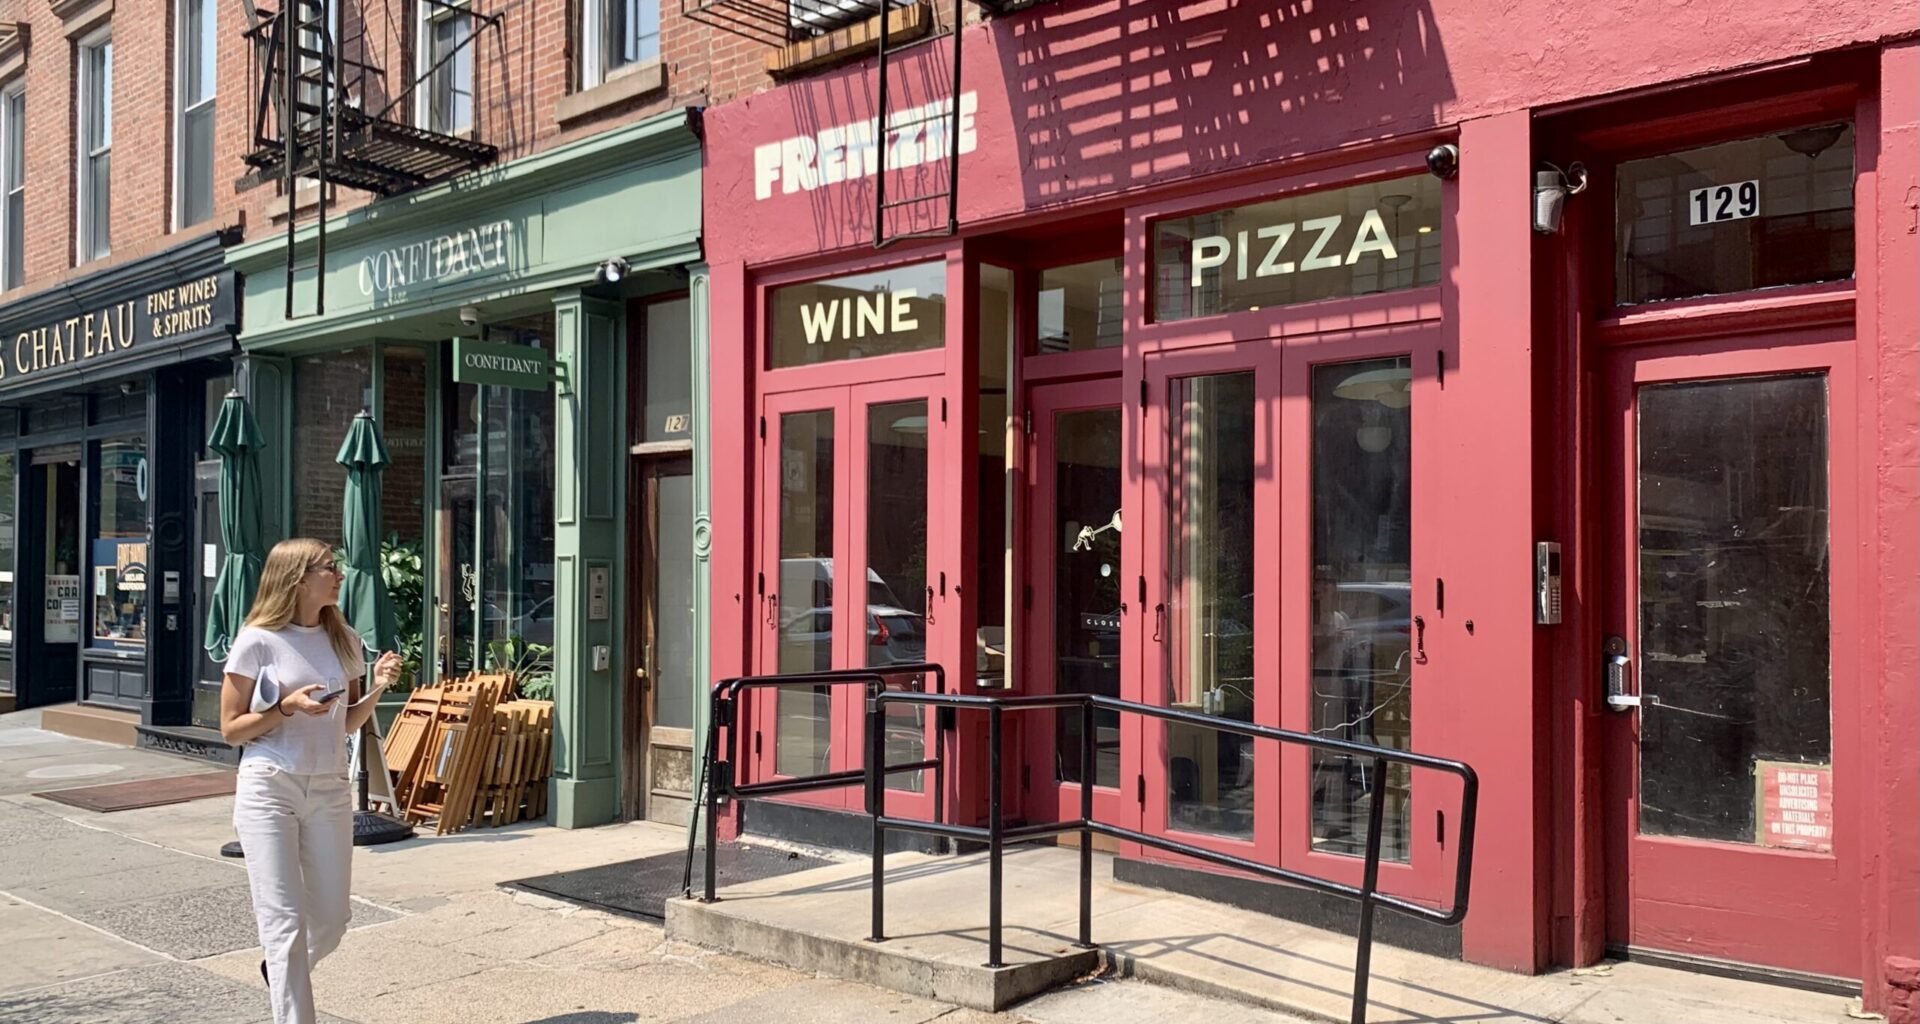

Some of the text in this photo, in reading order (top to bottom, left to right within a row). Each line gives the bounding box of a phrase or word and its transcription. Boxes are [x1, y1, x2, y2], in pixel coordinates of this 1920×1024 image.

[755, 91, 978, 201] FRENZIE
[1695, 182, 1756, 222] 129
[358, 219, 510, 297] CONFIDANT
[1191, 208, 1398, 288] PIZZA
[147, 275, 218, 315] FINE WINES
[152, 303, 212, 338] & SPIRITS
[800, 288, 919, 344] WINE
[15, 301, 136, 375] CHATEAU
[464, 353, 543, 376] CONFIDANT
[668, 416, 688, 430] 127
[1086, 619, 1120, 628] CLOSE
[1779, 784, 1818, 798] UNSOLICITED
[1786, 772, 1800, 785] NOT
[1800, 773, 1819, 787] PLACE
[1779, 797, 1818, 811] ADVERTISING
[1782, 810, 1815, 824] MATERIALS
[1782, 823, 1795, 836] THIS
[1796, 824, 1827, 838] PROPERTY
